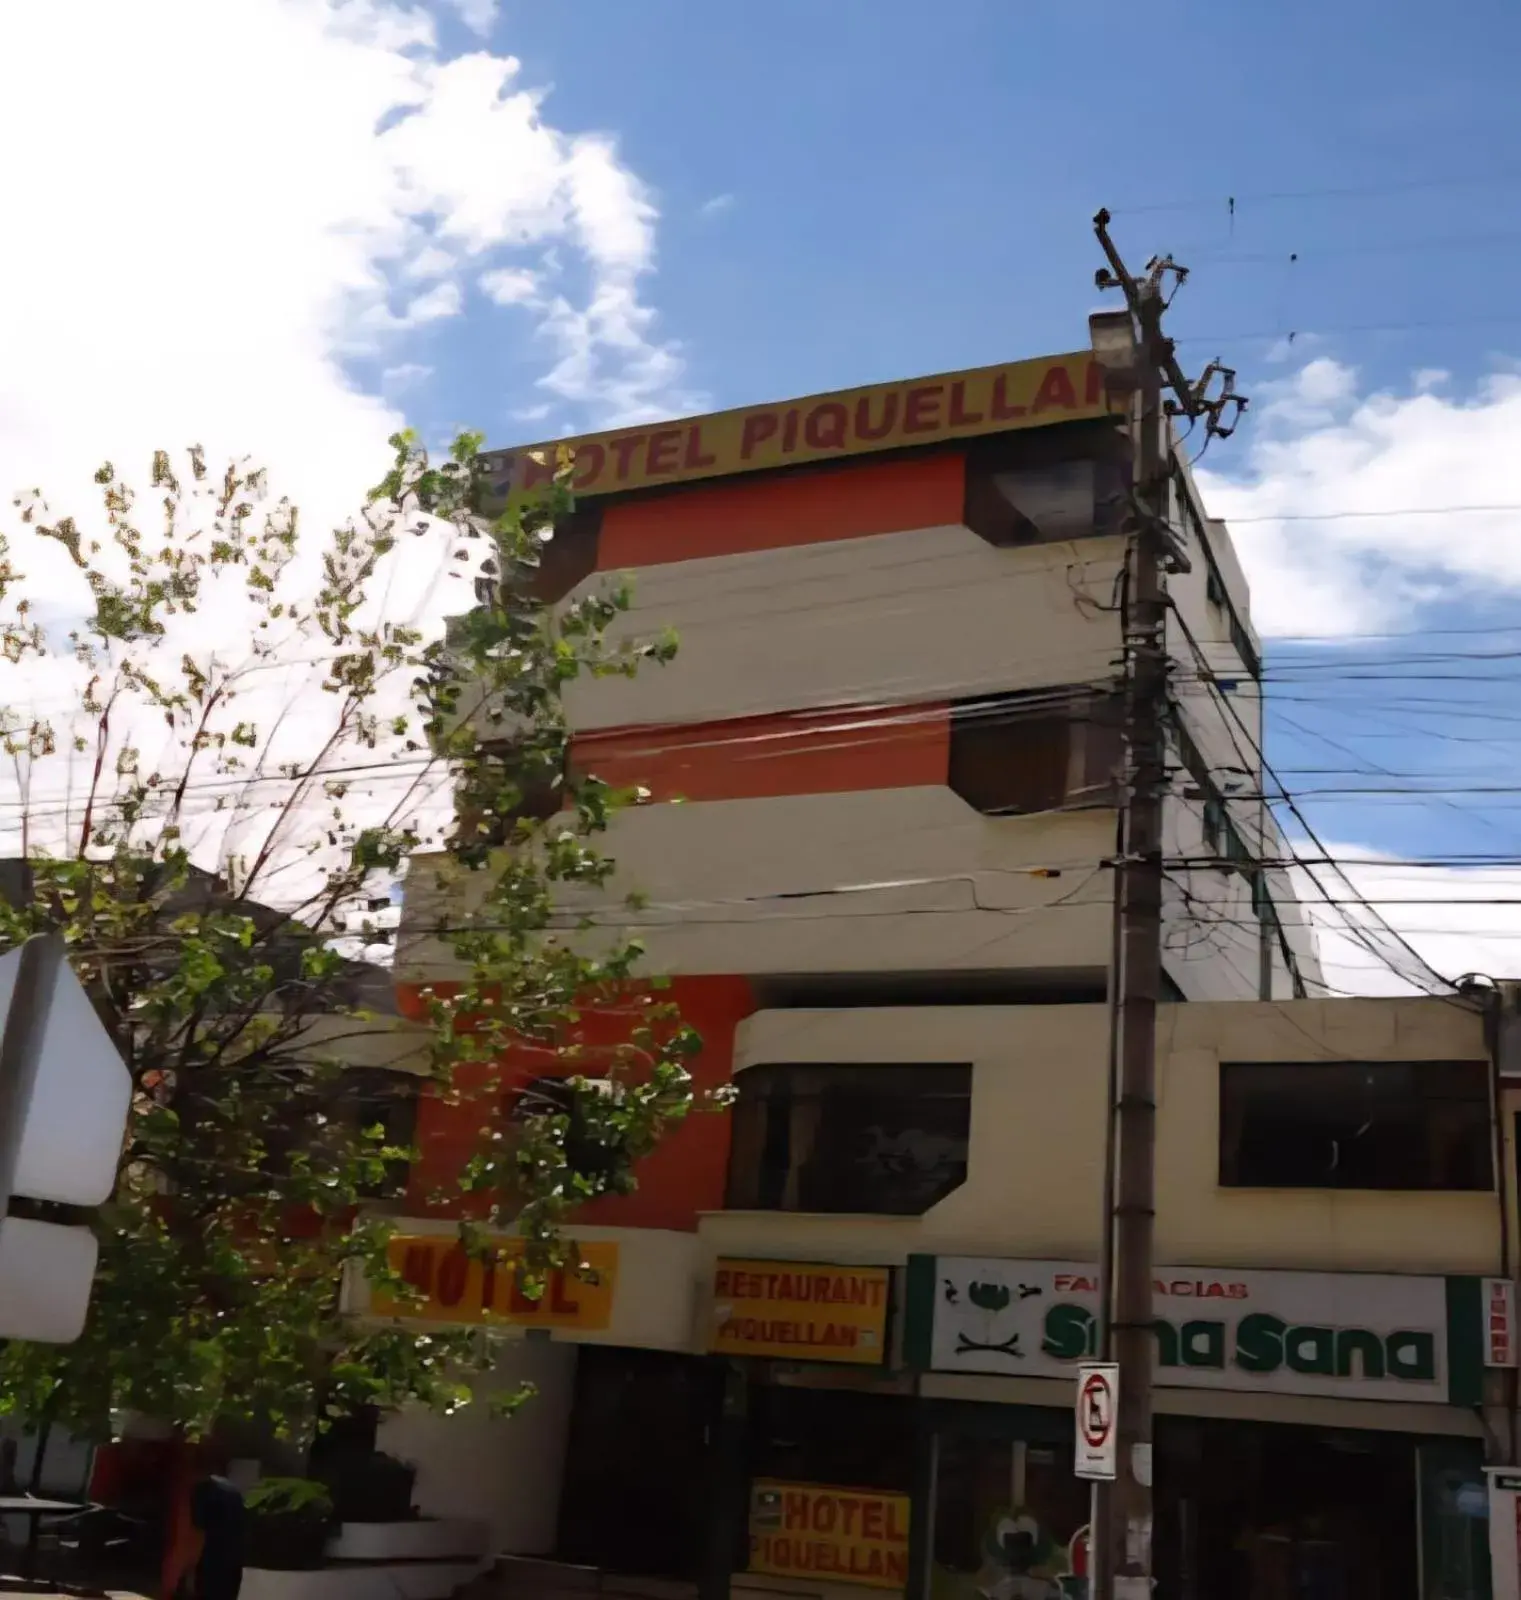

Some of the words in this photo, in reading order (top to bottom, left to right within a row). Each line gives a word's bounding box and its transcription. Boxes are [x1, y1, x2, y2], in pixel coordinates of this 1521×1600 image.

[715, 1270, 885, 1307] RESTAURANT
[1236, 1312, 1434, 1379] Sana
[785, 1491, 908, 1541] HOTEL
